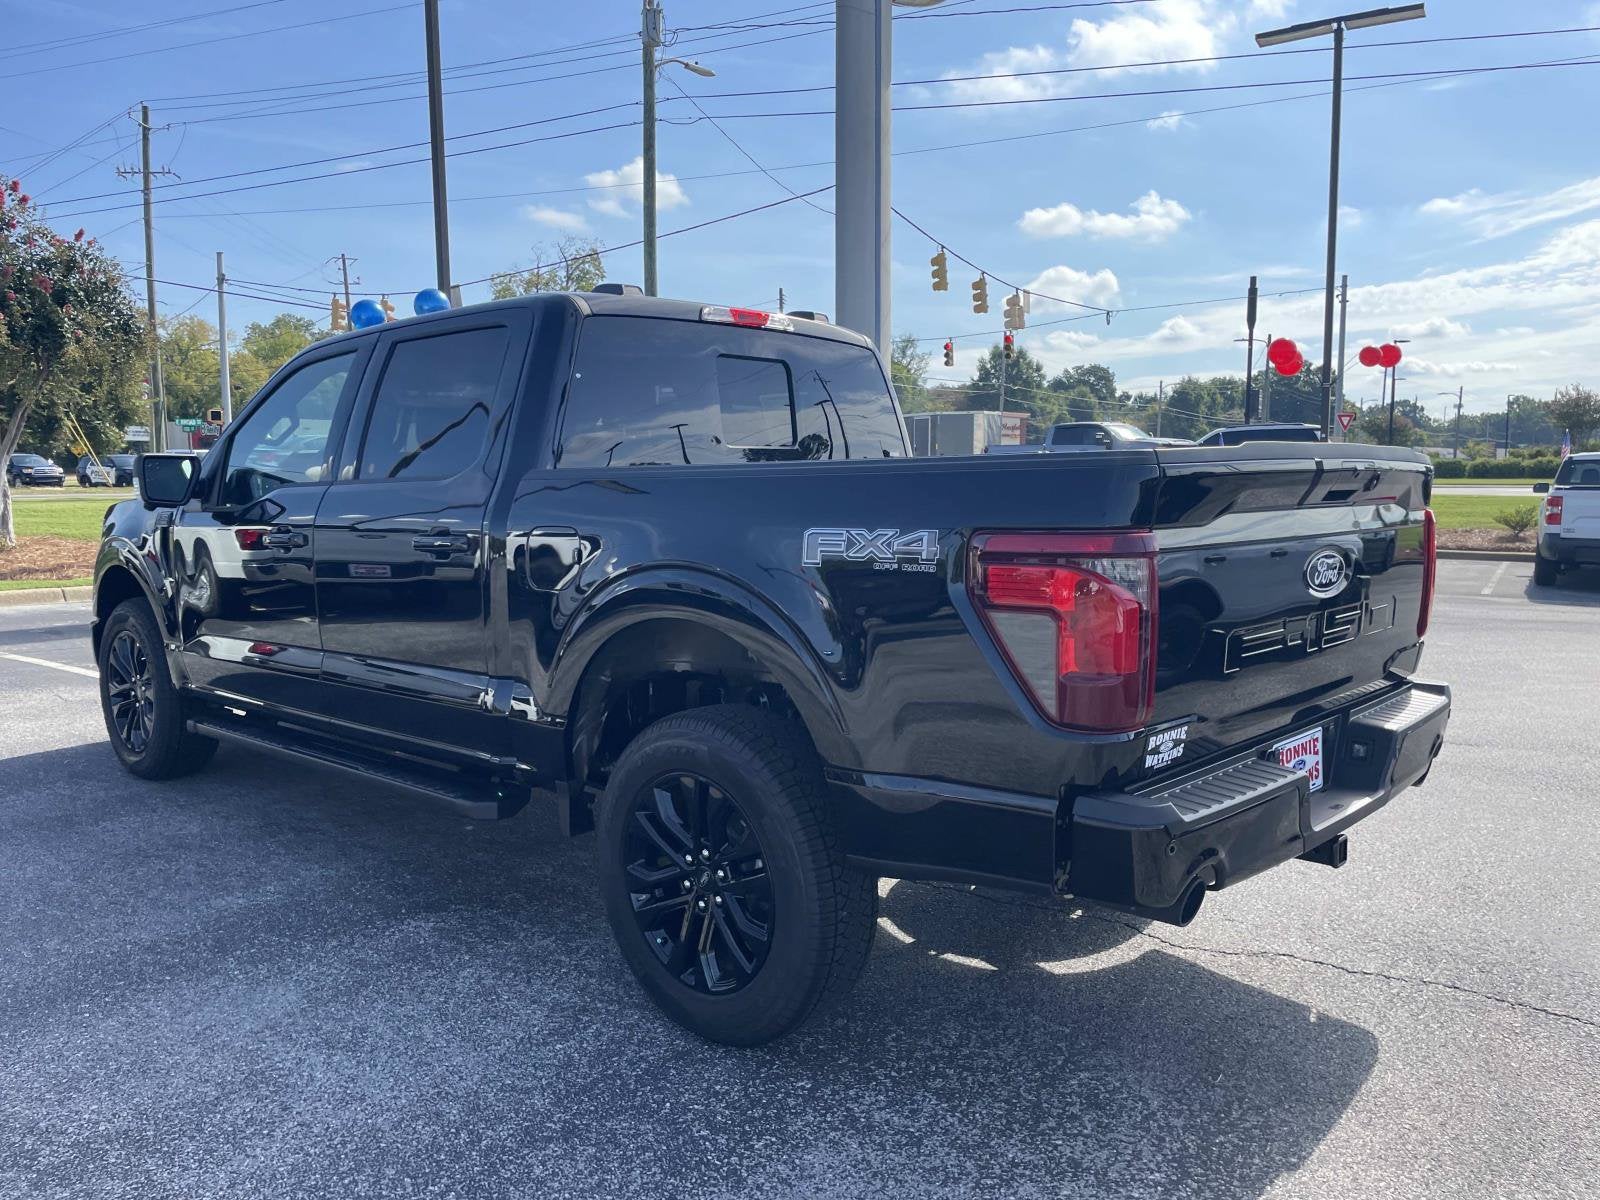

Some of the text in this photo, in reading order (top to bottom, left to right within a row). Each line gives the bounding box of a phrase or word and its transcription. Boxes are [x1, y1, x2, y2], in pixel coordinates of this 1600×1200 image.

[91, 470, 111, 478] POLE
[802, 528, 939, 567] FX4
[873, 562, 937, 572] OFF ROAD
[1314, 557, 1340, 585] Ford
[1147, 725, 1188, 751] RONNIE
[1279, 736, 1319, 766] RONNIE
[1145, 743, 1185, 769] WATKINS
